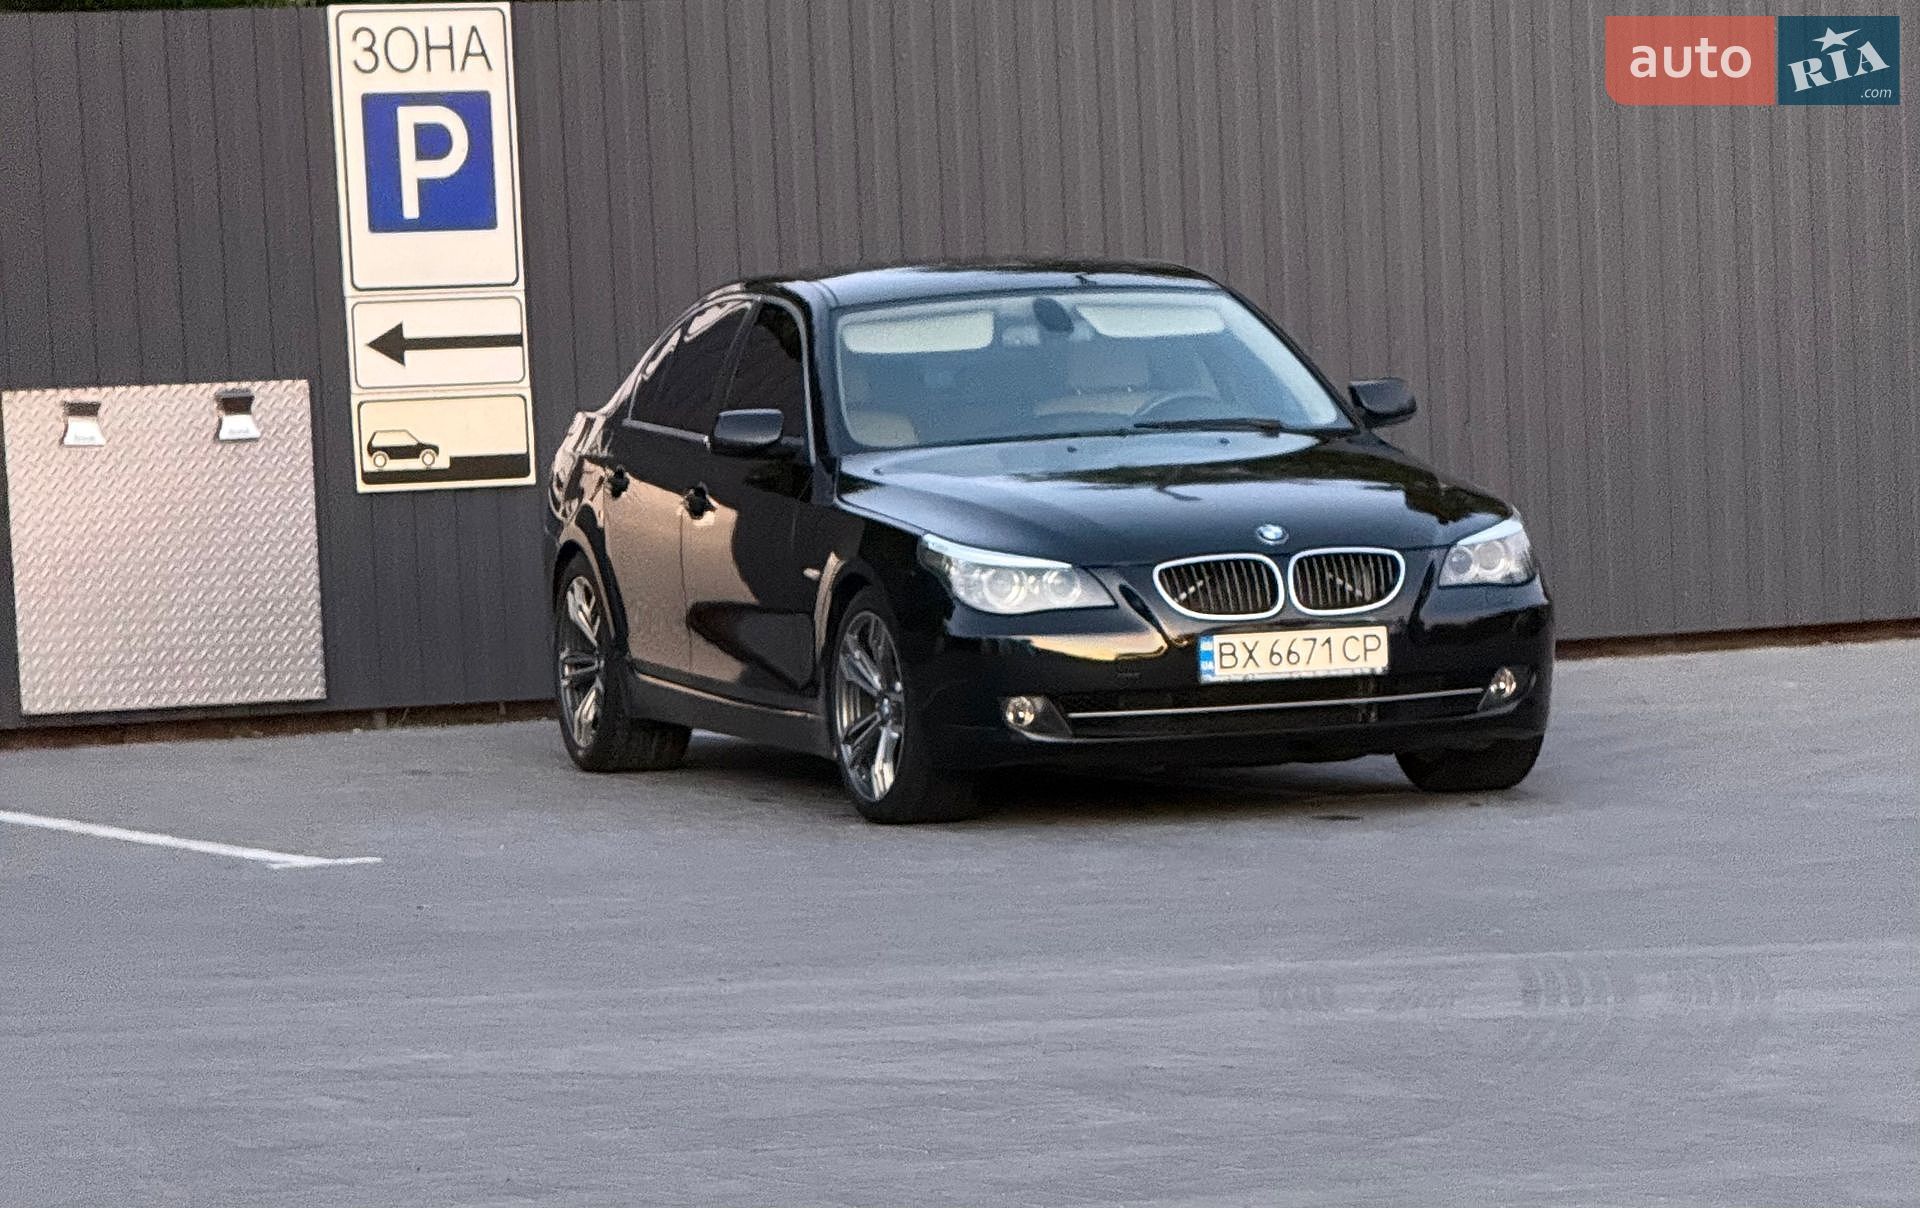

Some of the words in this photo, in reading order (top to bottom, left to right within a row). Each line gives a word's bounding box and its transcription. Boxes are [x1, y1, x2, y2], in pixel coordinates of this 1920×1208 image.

[352, 25, 493, 74] ЗОНА
[397, 105, 469, 220] P
[1218, 641, 1260, 669] BX
[1268, 636, 1332, 667] 6671
[1342, 634, 1382, 662] CP
